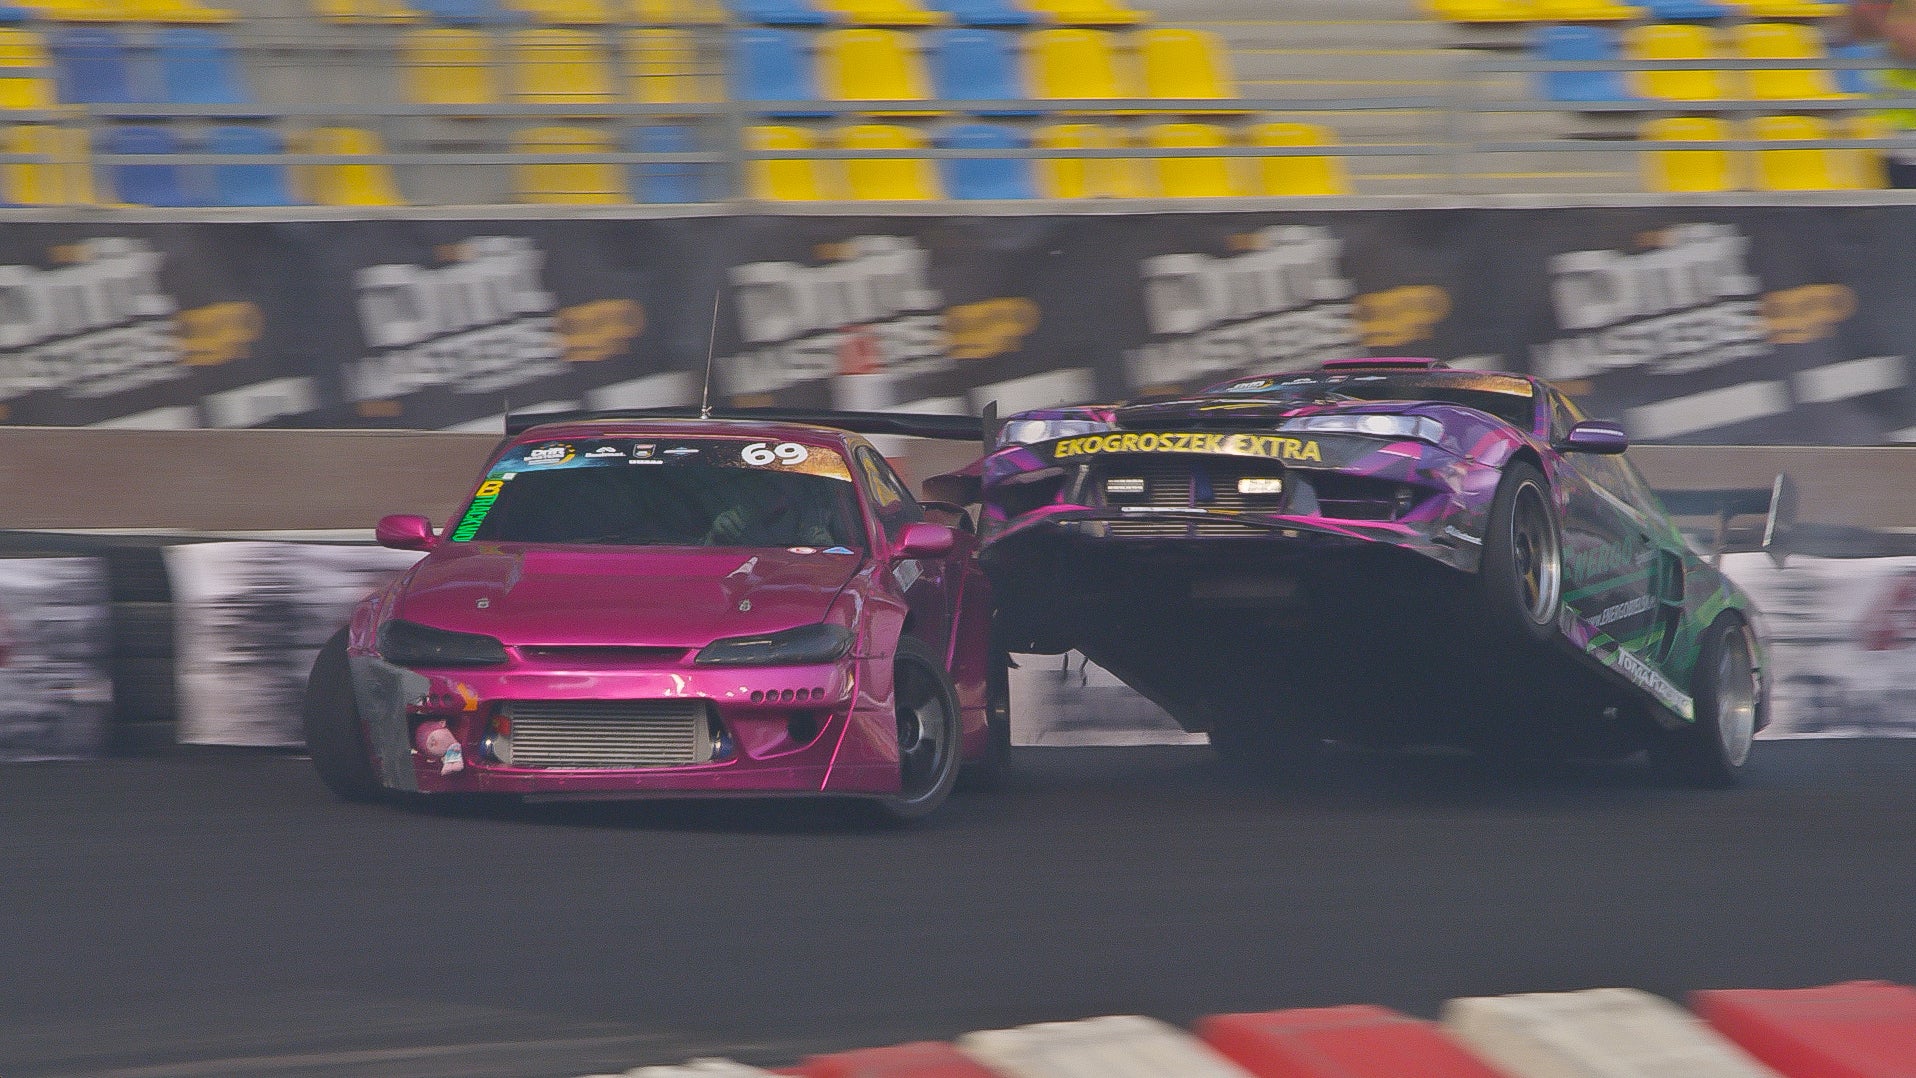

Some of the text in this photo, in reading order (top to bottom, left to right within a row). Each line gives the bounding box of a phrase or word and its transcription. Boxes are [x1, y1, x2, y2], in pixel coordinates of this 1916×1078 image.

[741, 442, 809, 466] 69
[1054, 433, 1322, 462] EKOGROSZEK EXTRA
